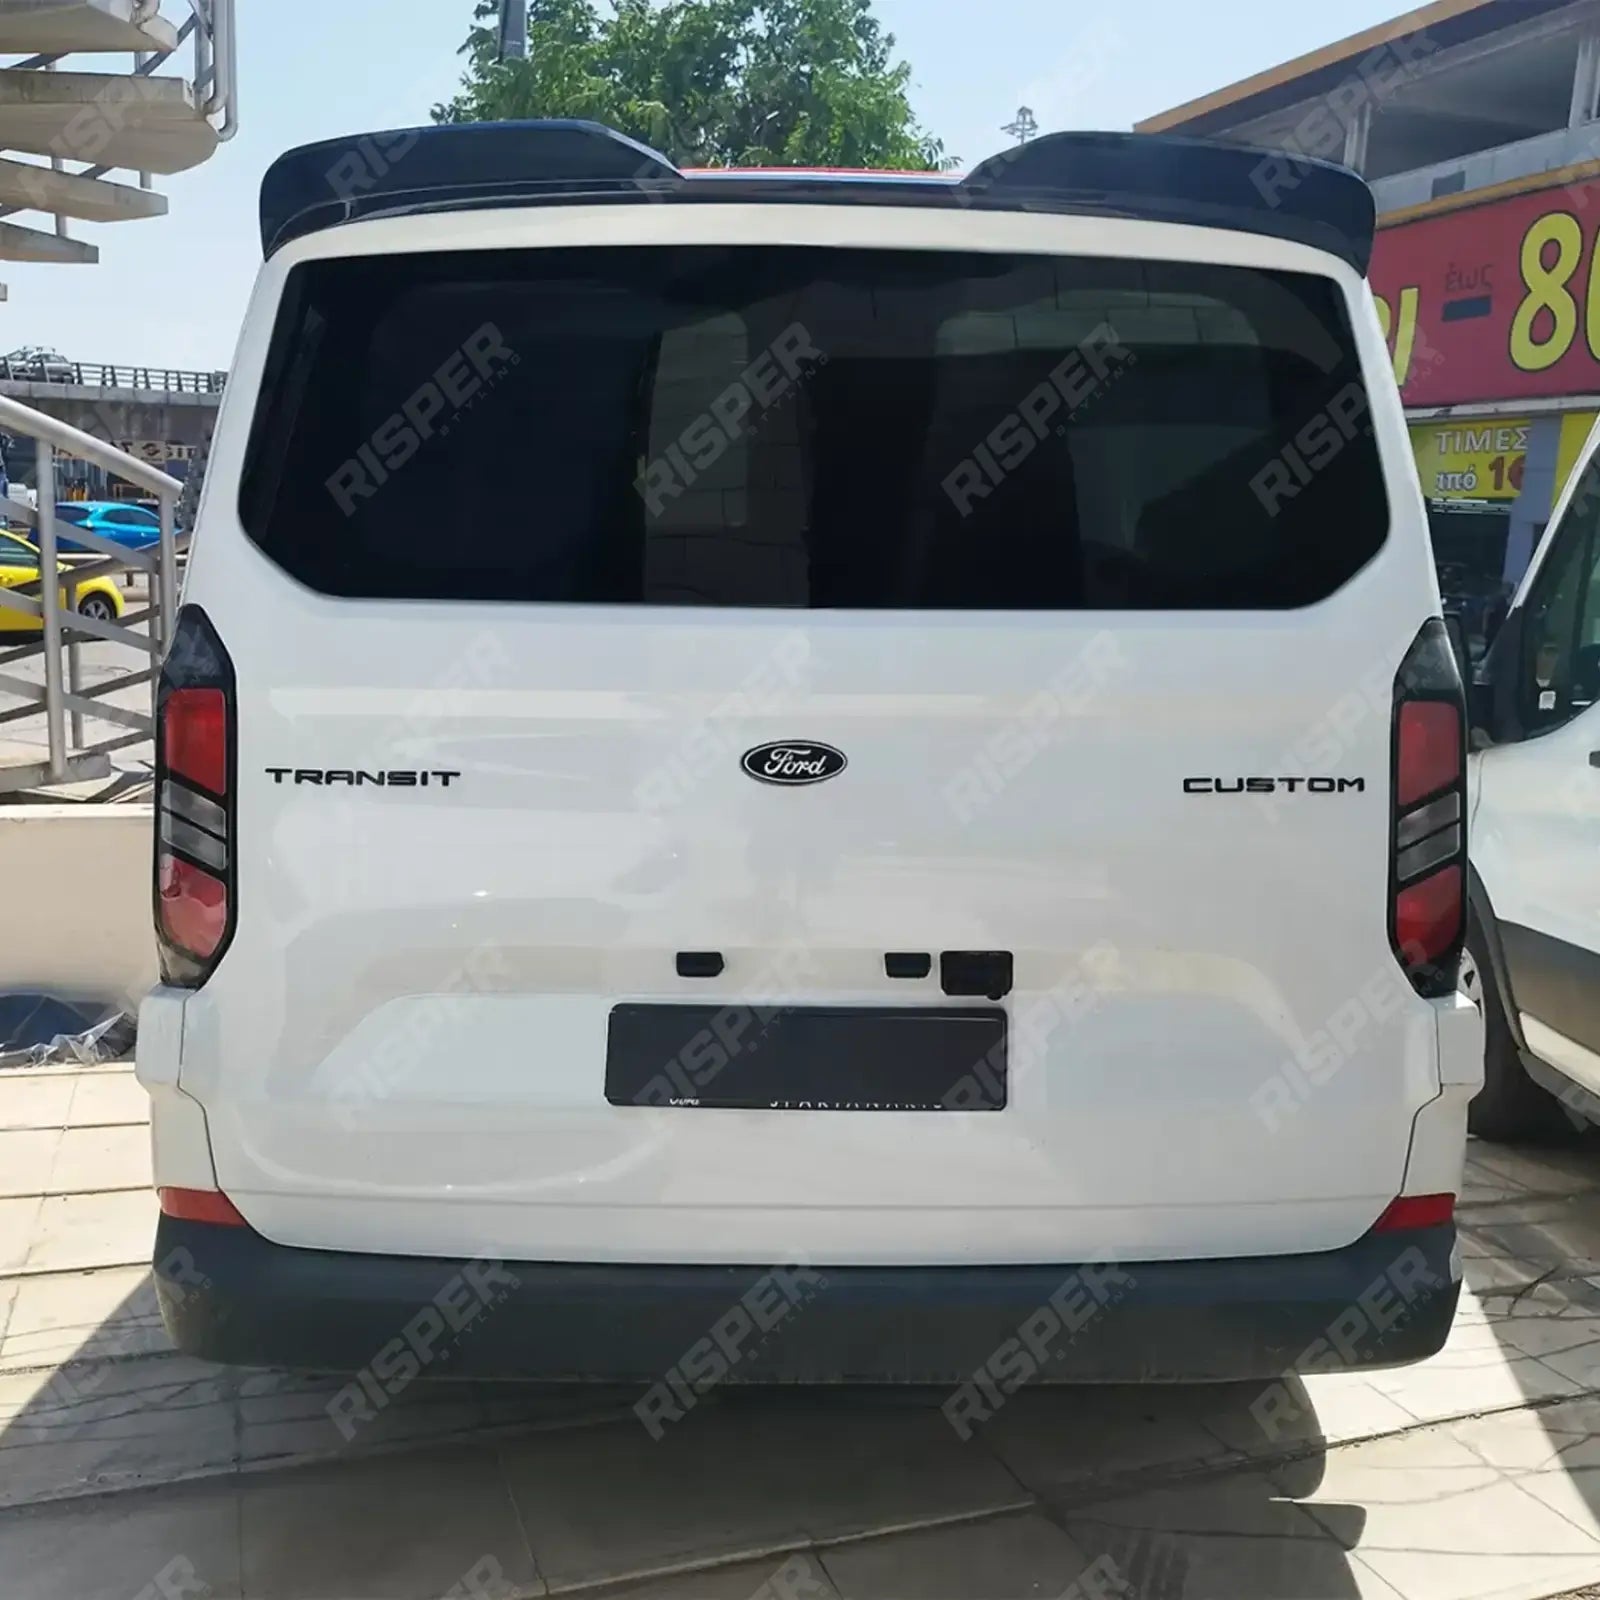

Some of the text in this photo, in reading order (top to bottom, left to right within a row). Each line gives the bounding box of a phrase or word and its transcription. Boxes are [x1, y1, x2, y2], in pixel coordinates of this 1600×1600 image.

[1436, 427, 1531, 454] ΤΙΜΕΣ
[764, 748, 827, 775] Ford
[265, 768, 461, 787] TRANSIT
[1183, 777, 1365, 793] CUSTOM
